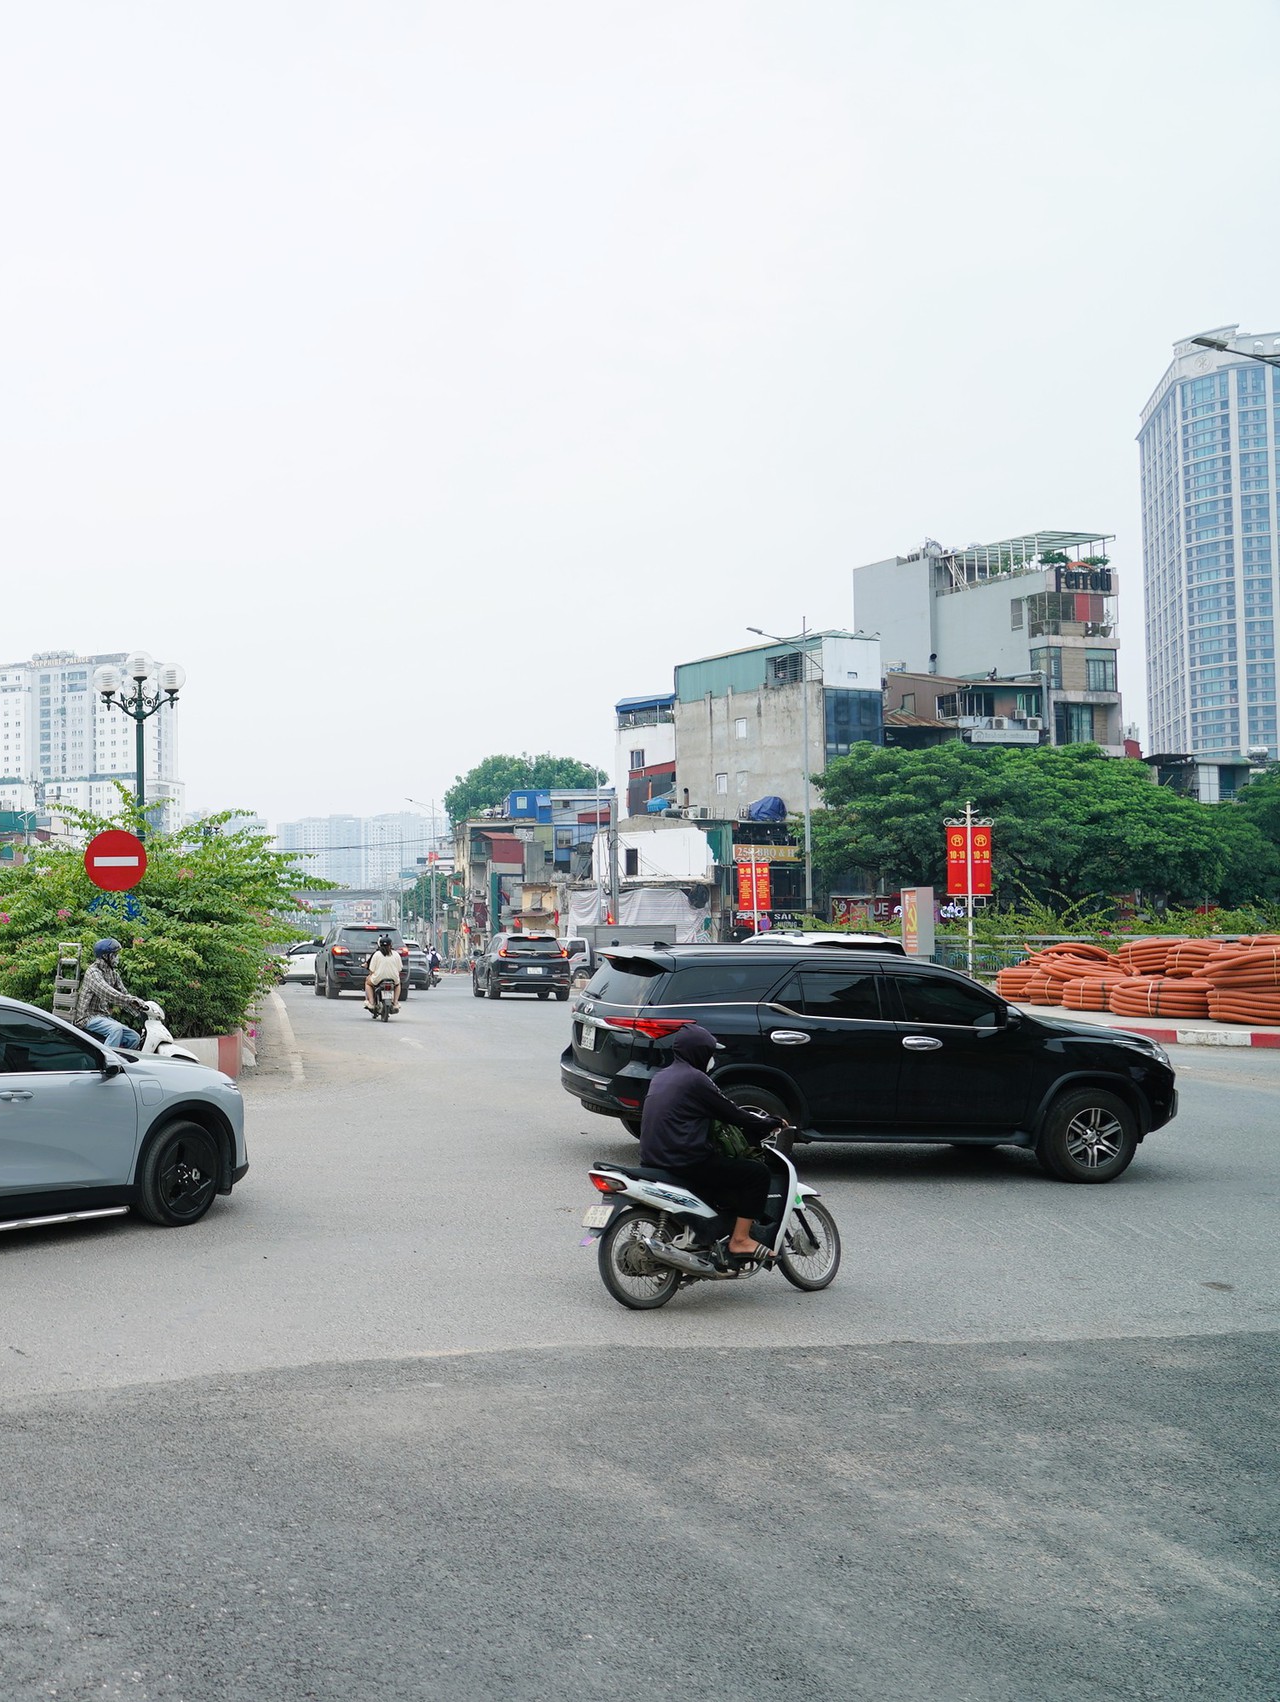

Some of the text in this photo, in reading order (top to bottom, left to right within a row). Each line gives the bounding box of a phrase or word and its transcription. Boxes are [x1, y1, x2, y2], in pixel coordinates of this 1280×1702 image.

[1056, 566, 1111, 592] Ferroli
[31, 655, 89, 668] SAPPHIRE PALACE
